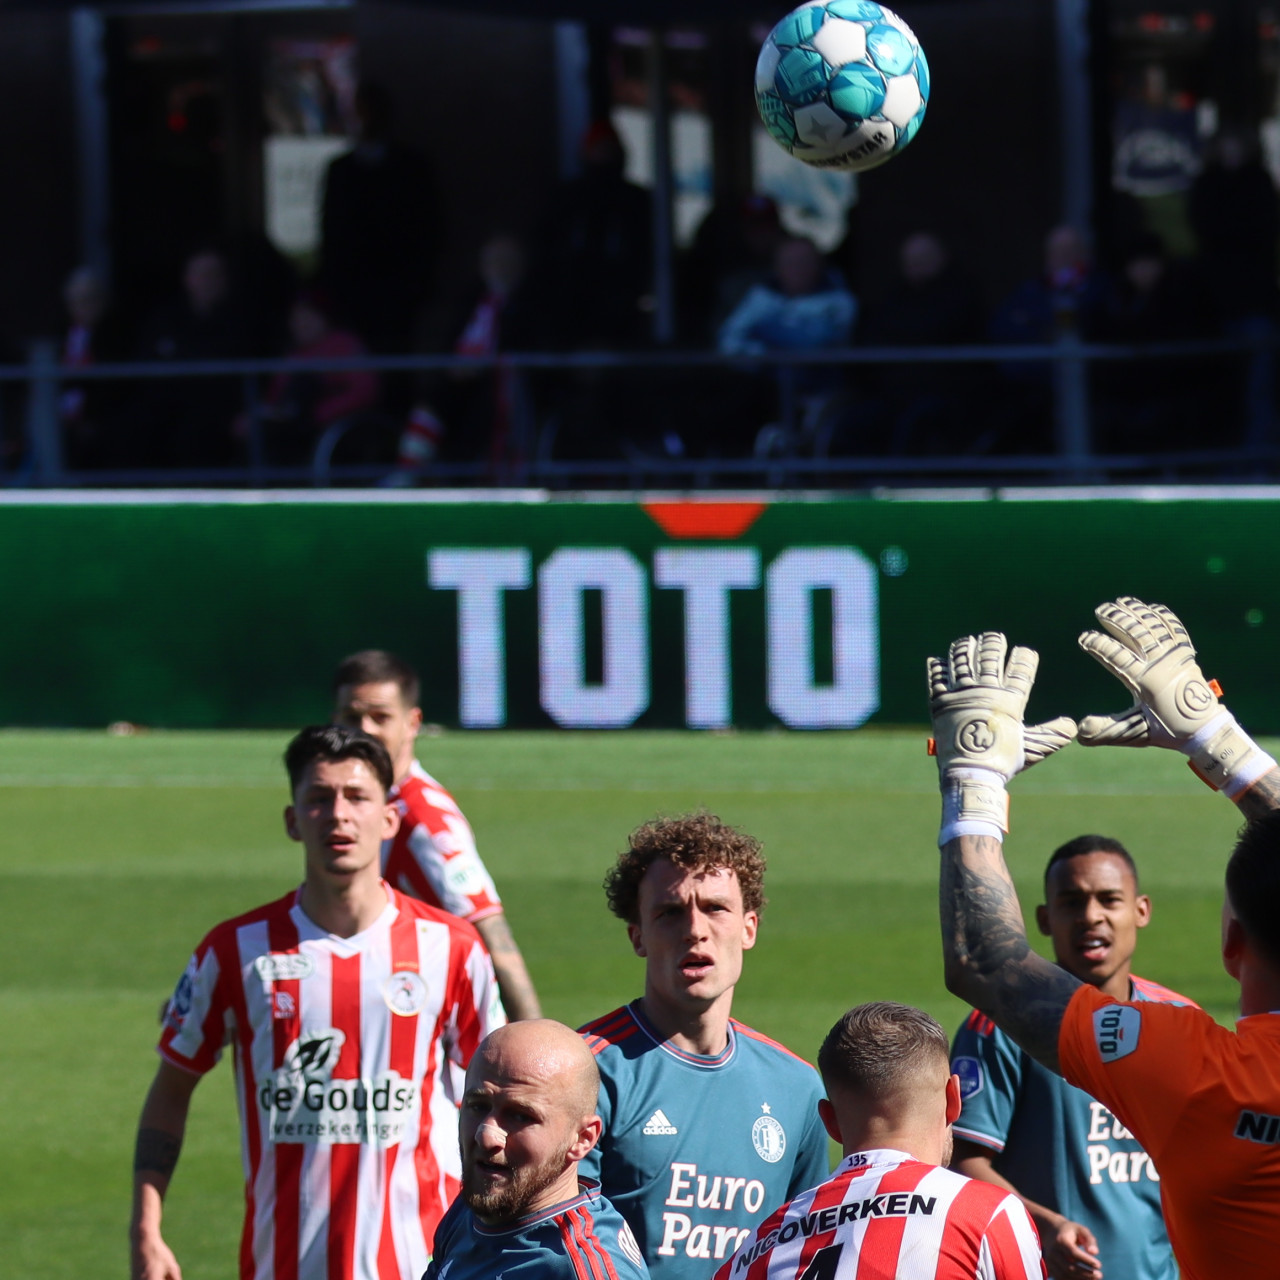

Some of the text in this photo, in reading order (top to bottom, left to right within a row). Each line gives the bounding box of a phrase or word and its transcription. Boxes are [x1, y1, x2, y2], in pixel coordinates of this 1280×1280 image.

[426, 545, 881, 730] TOTO
[1099, 1008, 1122, 1054] TOTO
[259, 1080, 292, 1112] de
[642, 1126, 678, 1136] adidas
[1087, 1101, 1135, 1142] Eu
[848, 1154, 868, 1167] 135
[665, 1162, 765, 1214] Euro
[735, 1193, 938, 1275] NICOVERKEN
